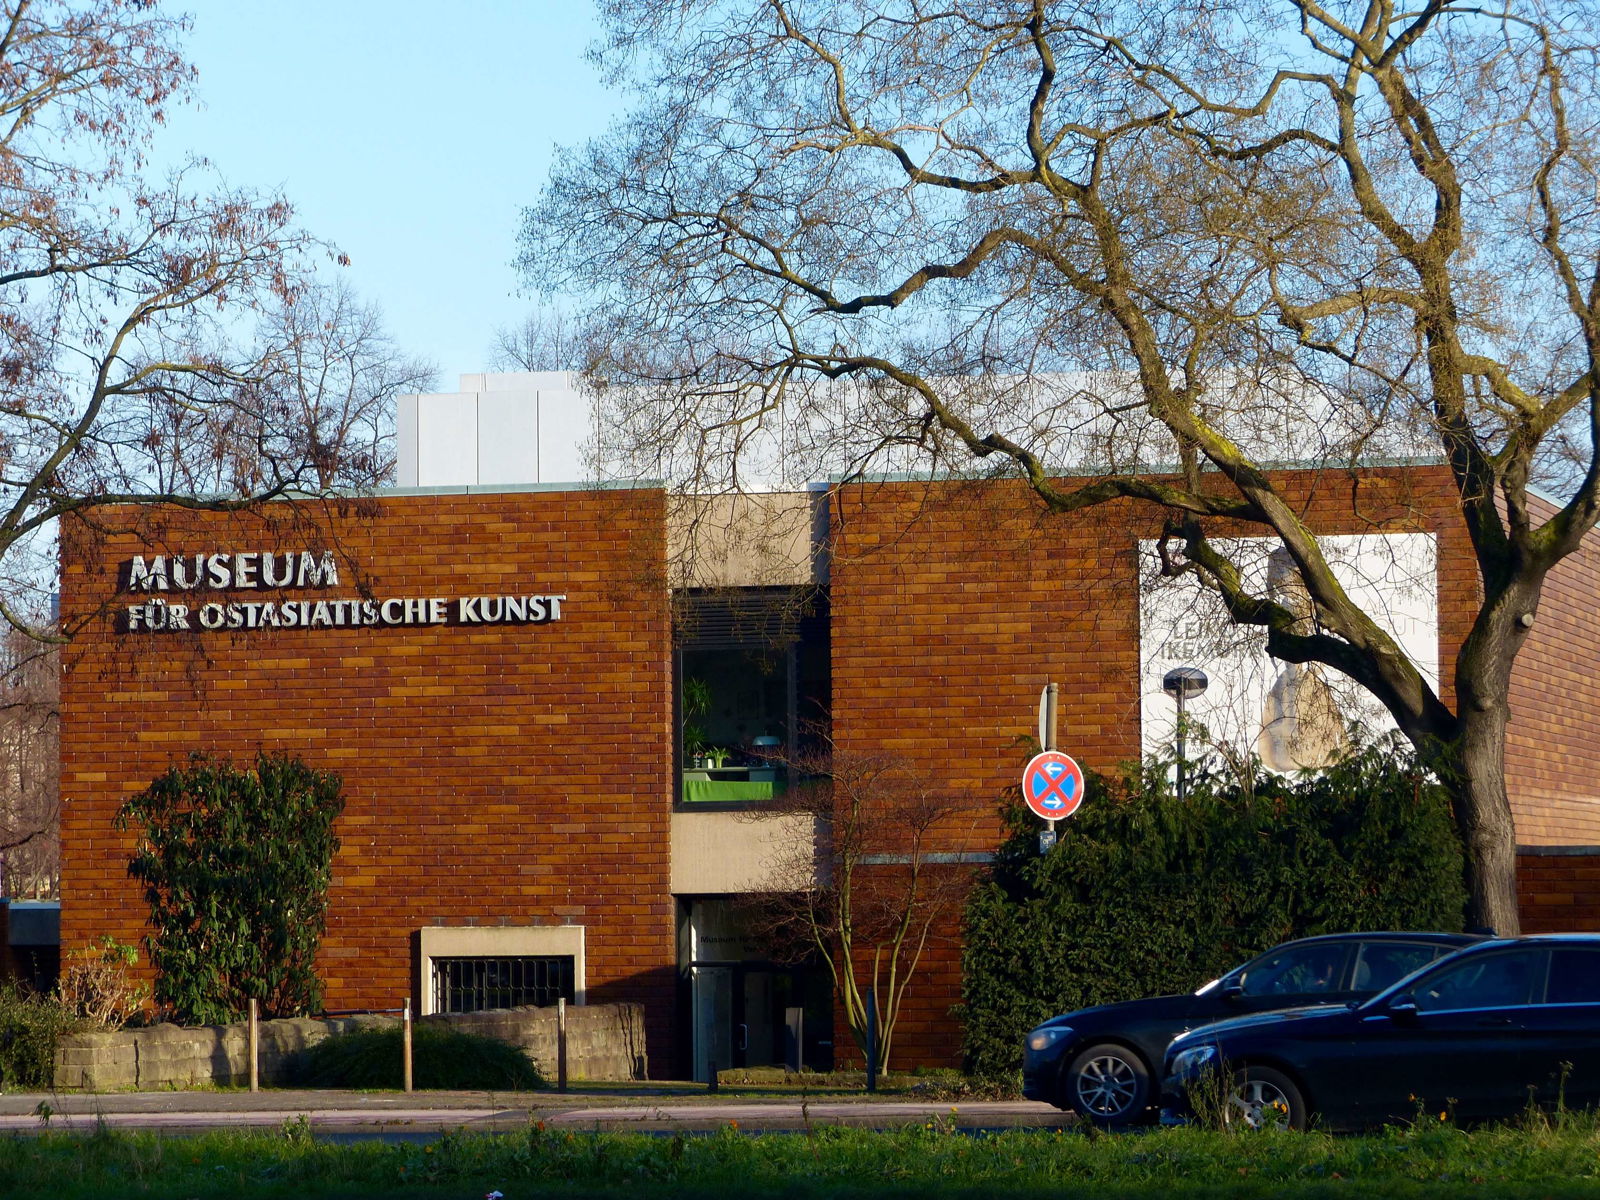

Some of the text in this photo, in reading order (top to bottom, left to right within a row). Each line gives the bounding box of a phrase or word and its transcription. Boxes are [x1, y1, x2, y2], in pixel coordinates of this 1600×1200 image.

[130, 551, 338, 590] MUSEUM
[128, 595, 566, 629] FÜR OSTASIATISCHE KUNST
